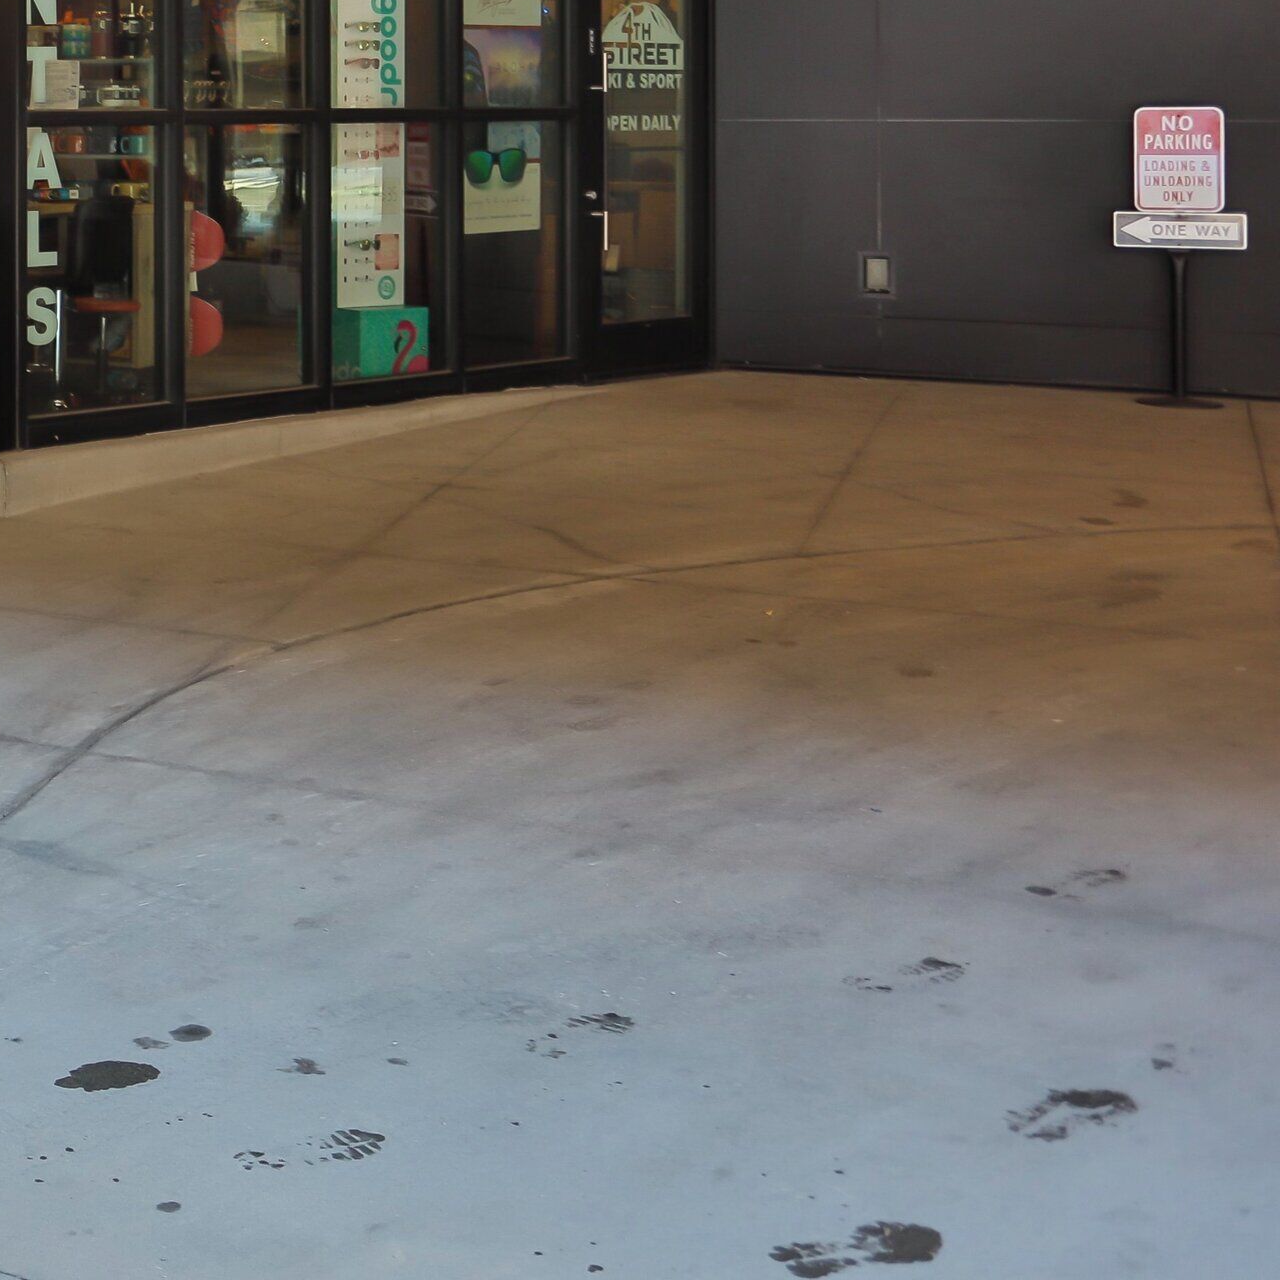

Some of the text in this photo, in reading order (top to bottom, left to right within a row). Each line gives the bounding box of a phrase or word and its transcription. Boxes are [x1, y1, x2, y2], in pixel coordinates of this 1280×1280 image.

[621, 11, 651, 41] 4TH
[602, 41, 681, 66] STREET
[608, 72, 683, 90] KI & SPORT
[607, 114, 682, 132] PEN DAILY
[1161, 115, 1194, 132] NO
[1143, 133, 1213, 150] PARKING
[1144, 160, 1211, 171] LOADING &
[1143, 175, 1213, 187] UNLOADING
[1162, 190, 1194, 202] ONLY
[1151, 223, 1232, 238] ONE WAY
